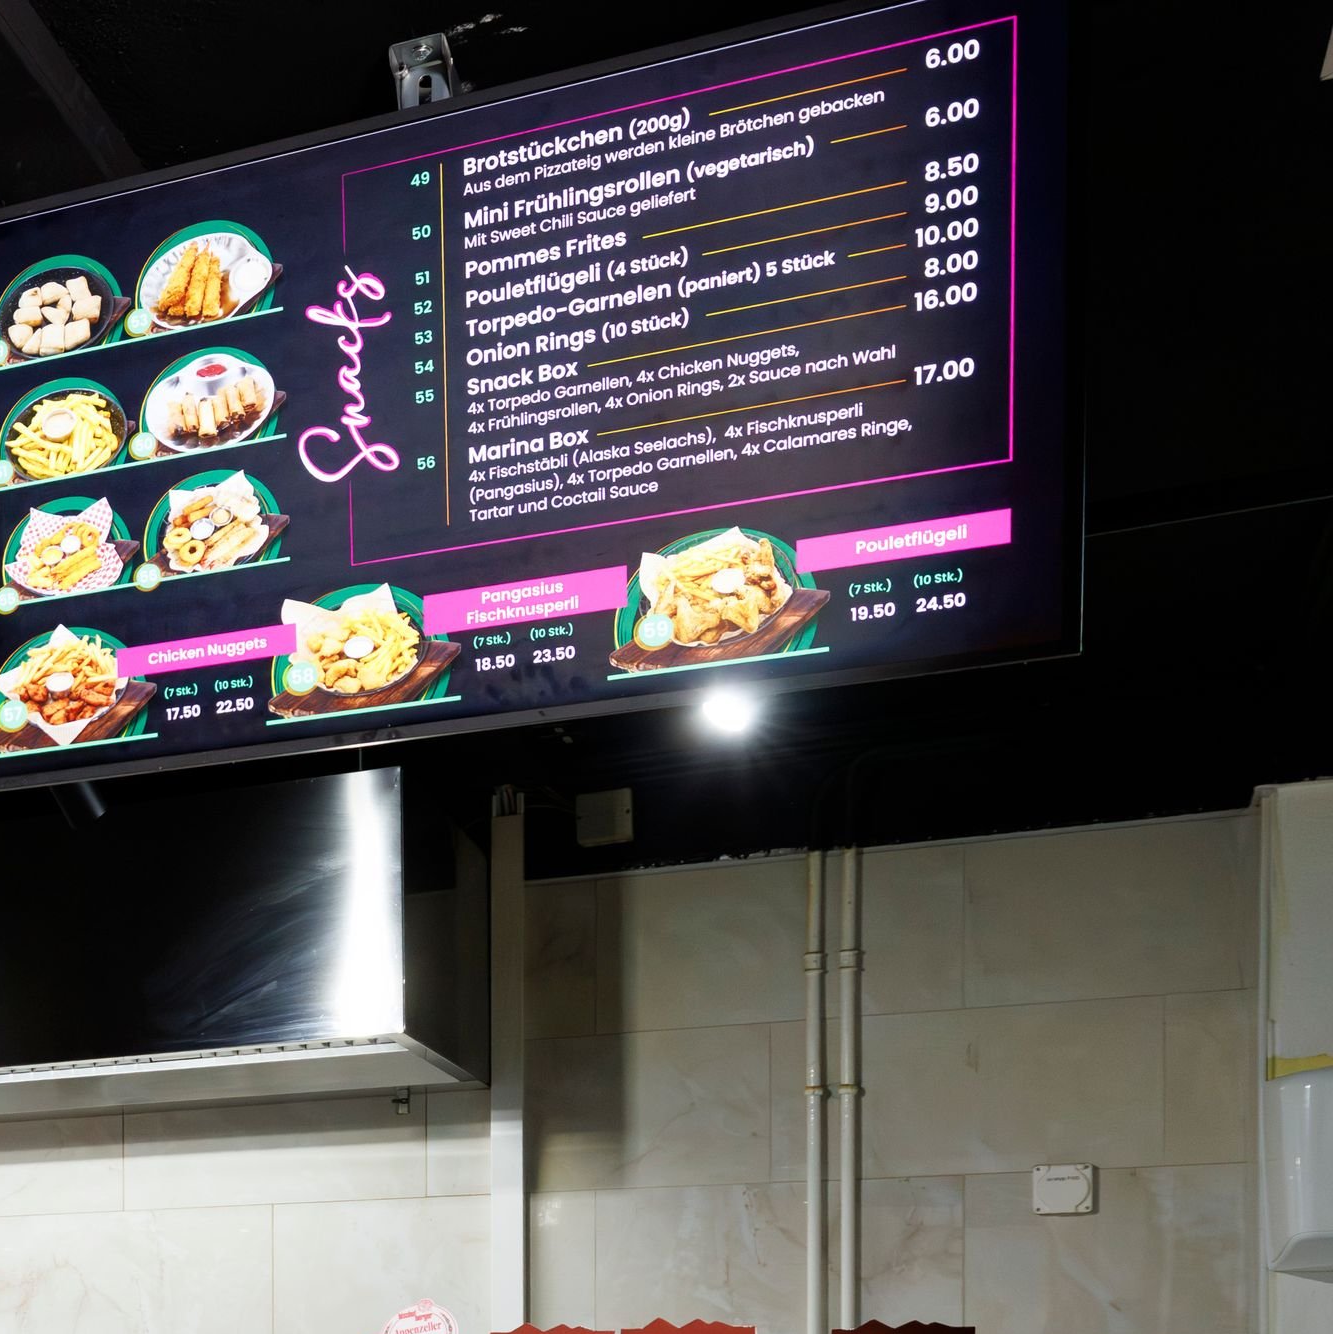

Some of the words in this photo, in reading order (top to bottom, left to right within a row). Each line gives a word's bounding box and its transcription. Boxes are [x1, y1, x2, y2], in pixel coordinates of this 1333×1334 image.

[410, 171, 430, 187] 49
[463, 126, 623, 177] Brotstückchen
[628, 106, 691, 141] (200g)
[925, 38, 980, 69] 6.00
[463, 180, 492, 197] Aus
[494, 171, 531, 189] dem
[534, 153, 602, 180] Pizzateig
[604, 140, 665, 164] werden
[668, 128, 716, 150] kleine
[720, 111, 795, 138] Brötchen
[798, 90, 885, 124] gebacken
[412, 224, 432, 241] 50
[464, 201, 509, 230] Mini
[514, 168, 681, 219] Frühlingsrollen
[686, 134, 815, 184] (vegetarisch)
[925, 97, 980, 128] 6.00
[415, 270, 430, 286] 51
[465, 245, 562, 279] Pommes
[566, 231, 627, 258] Frites
[924, 152, 980, 182] 8.50
[464, 232, 488, 250] Mit
[490, 221, 537, 244] Sweet
[539, 212, 574, 233] Chili
[577, 204, 627, 225] Sauce
[629, 187, 697, 218] geliefert
[414, 299, 433, 316] 52
[465, 261, 601, 309] Pouletflügeli
[606, 259, 627, 282] (4
[629, 245, 689, 274] Stück)
[924, 185, 979, 214] 9.00
[414, 329, 433, 345] 53
[465, 283, 672, 337] Torpedo-Garnelen
[677, 261, 761, 299] (paniert)
[765, 260, 778, 277] 5
[781, 250, 836, 275] Stück
[915, 217, 979, 248] 10.00
[414, 359, 435, 375] 54
[466, 341, 531, 367] Onion
[535, 328, 597, 354] Rings
[601, 321, 628, 344] (10
[630, 306, 690, 335] Stück)
[924, 249, 979, 278] 8.00
[415, 388, 435, 404] 55
[466, 367, 534, 396] Snack
[538, 361, 579, 383] Box
[914, 281, 978, 312] 16.00
[298, 265, 400, 483] Snacks
[417, 455, 436, 471] 56
[468, 437, 544, 464] Marina
[549, 429, 589, 450] Box
[913, 357, 975, 386] 17.00
[481, 581, 563, 605] Pangasius
[855, 524, 968, 556] Pouletflügeli
[148, 647, 205, 665] Chicken
[207, 637, 267, 658] Nuggets
[466, 596, 579, 625] Fischknusperli
[475, 653, 515, 672] 18.50
[532, 645, 575, 665] 23.50
[850, 602, 896, 622] 19.50
[915, 592, 966, 614] 24.50
[166, 704, 201, 721] 17.50
[216, 697, 254, 715] 22.50
